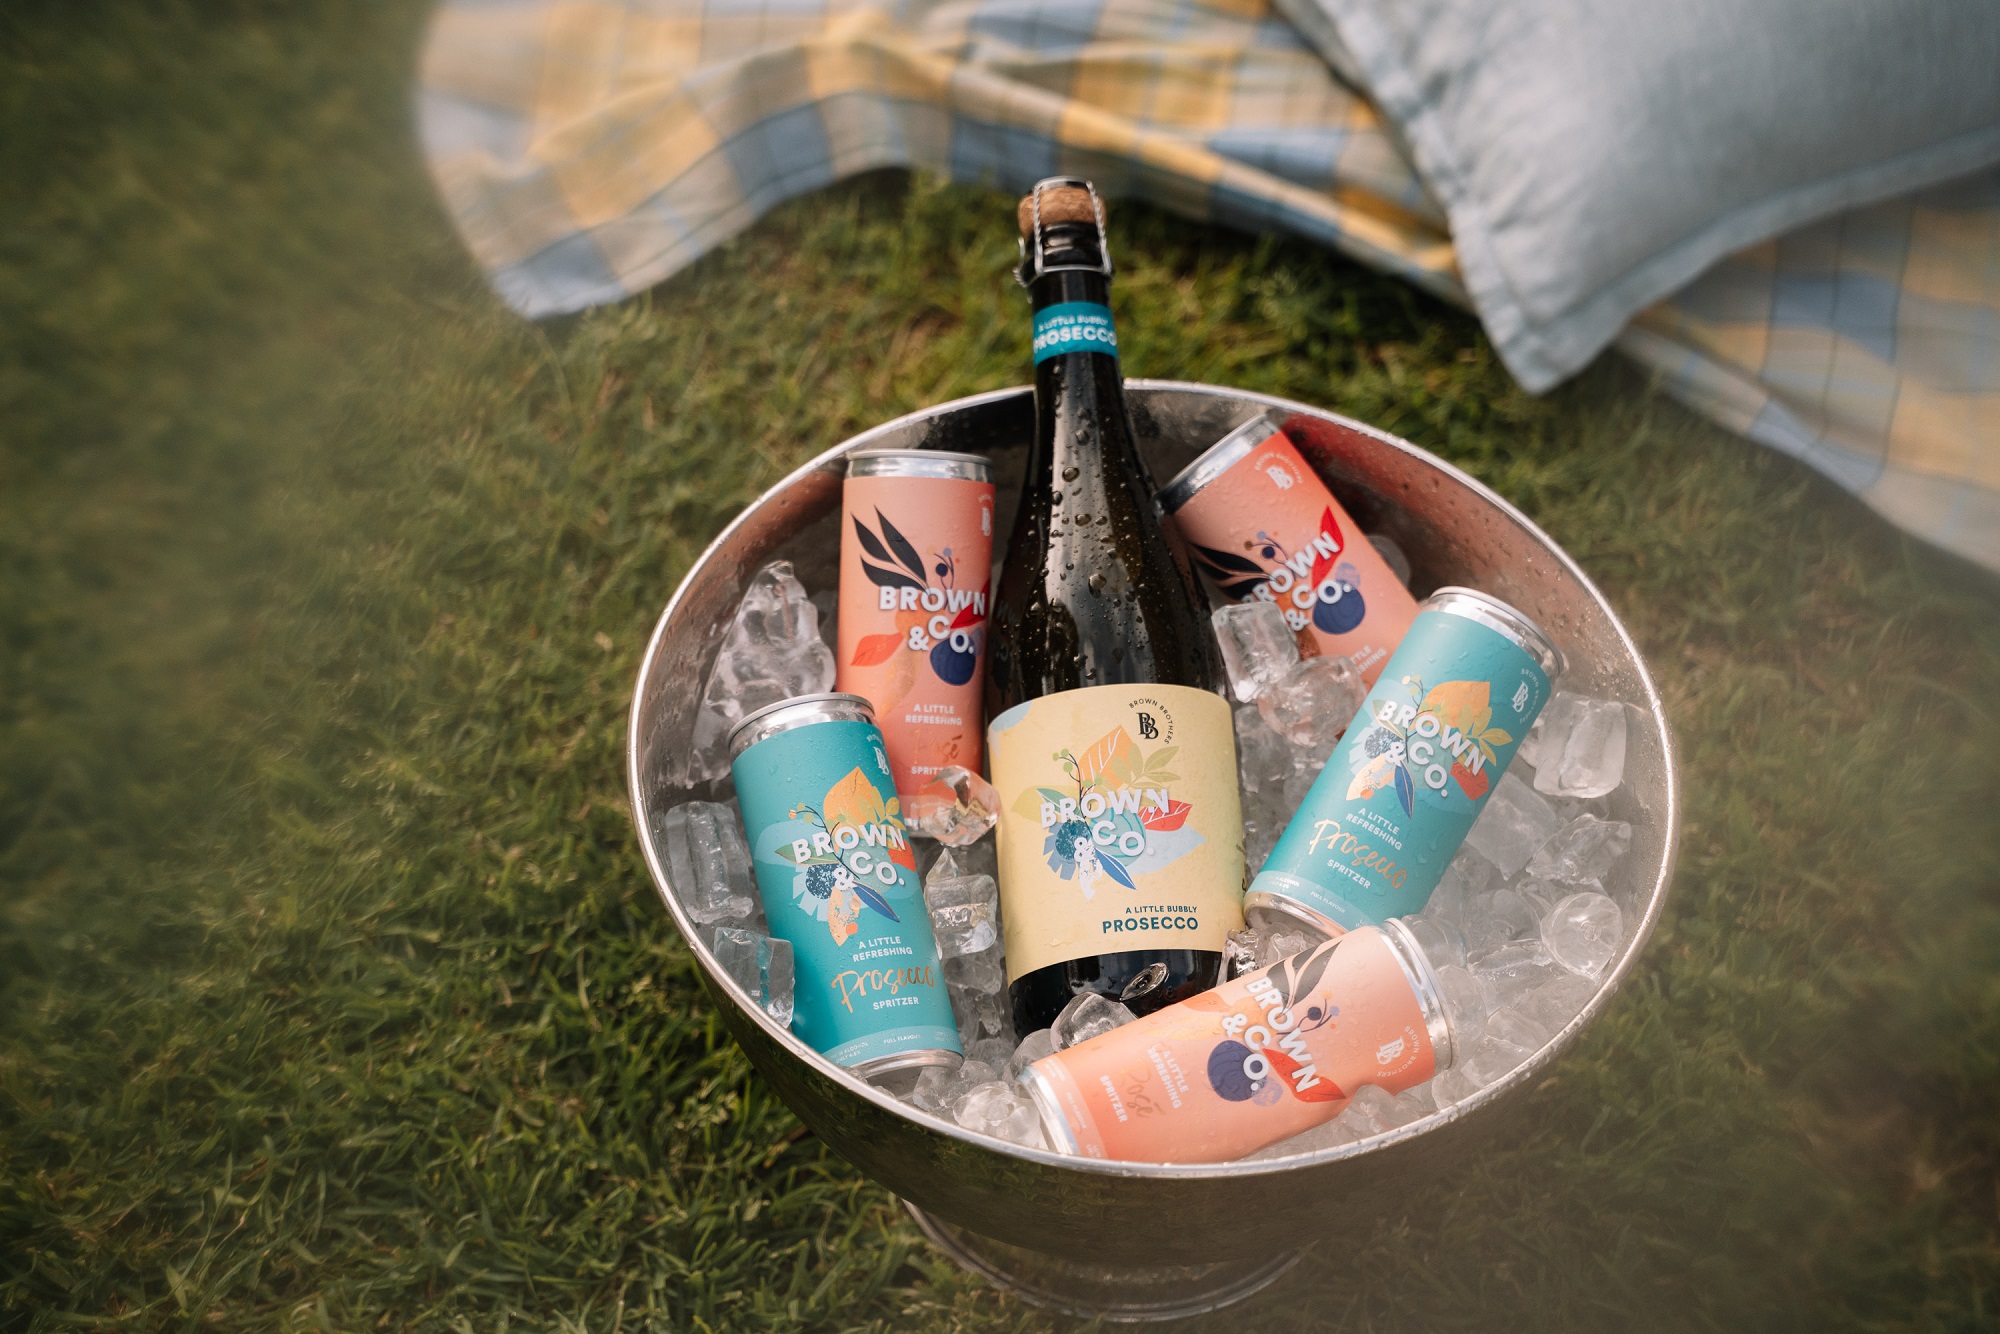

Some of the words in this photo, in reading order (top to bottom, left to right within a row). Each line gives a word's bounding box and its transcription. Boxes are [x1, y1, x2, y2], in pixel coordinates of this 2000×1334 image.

[879, 585, 985, 616] BROWN
[905, 714, 963, 726] REFRESHING
[913, 704, 921, 713] A
[923, 704, 955, 715] LITTLE
[1128, 698, 1158, 709] BROWN
[1159, 705, 1174, 744] BROTHERS
[1378, 700, 1487, 776] BROWN
[911, 766, 944, 775] SPRIT
[1039, 788, 1170, 829] BROWN
[1358, 807, 1366, 816] A
[1367, 811, 1400, 835] LITTLE
[792, 824, 906, 864] BROWN
[1345, 813, 1403, 851] REFRESHING
[1308, 818, 1408, 889] Prosecco
[1326, 859, 1371, 889] SPRITZER
[1134, 905, 1165, 914] LITTLE
[1167, 905, 1198, 914] BUBBLY
[1102, 916, 1199, 934] PROSECCO
[852, 947, 913, 963] REFRESHING
[858, 941, 867, 950] A
[868, 936, 901, 948] LITTLE
[830, 965, 935, 1014] Prosecco
[872, 996, 920, 1011] SPRITZER
[1246, 976, 1320, 1093] BROWN
[1404, 1025, 1420, 1053] BROWN
[1147, 1047, 1182, 1109] REFRESHING
[1163, 1051, 1171, 1059] A
[1167, 1058, 1189, 1093] LITTLE
[1376, 1055, 1416, 1077] BROTHERS
[1100, 1075, 1128, 1123] SPRITZER
